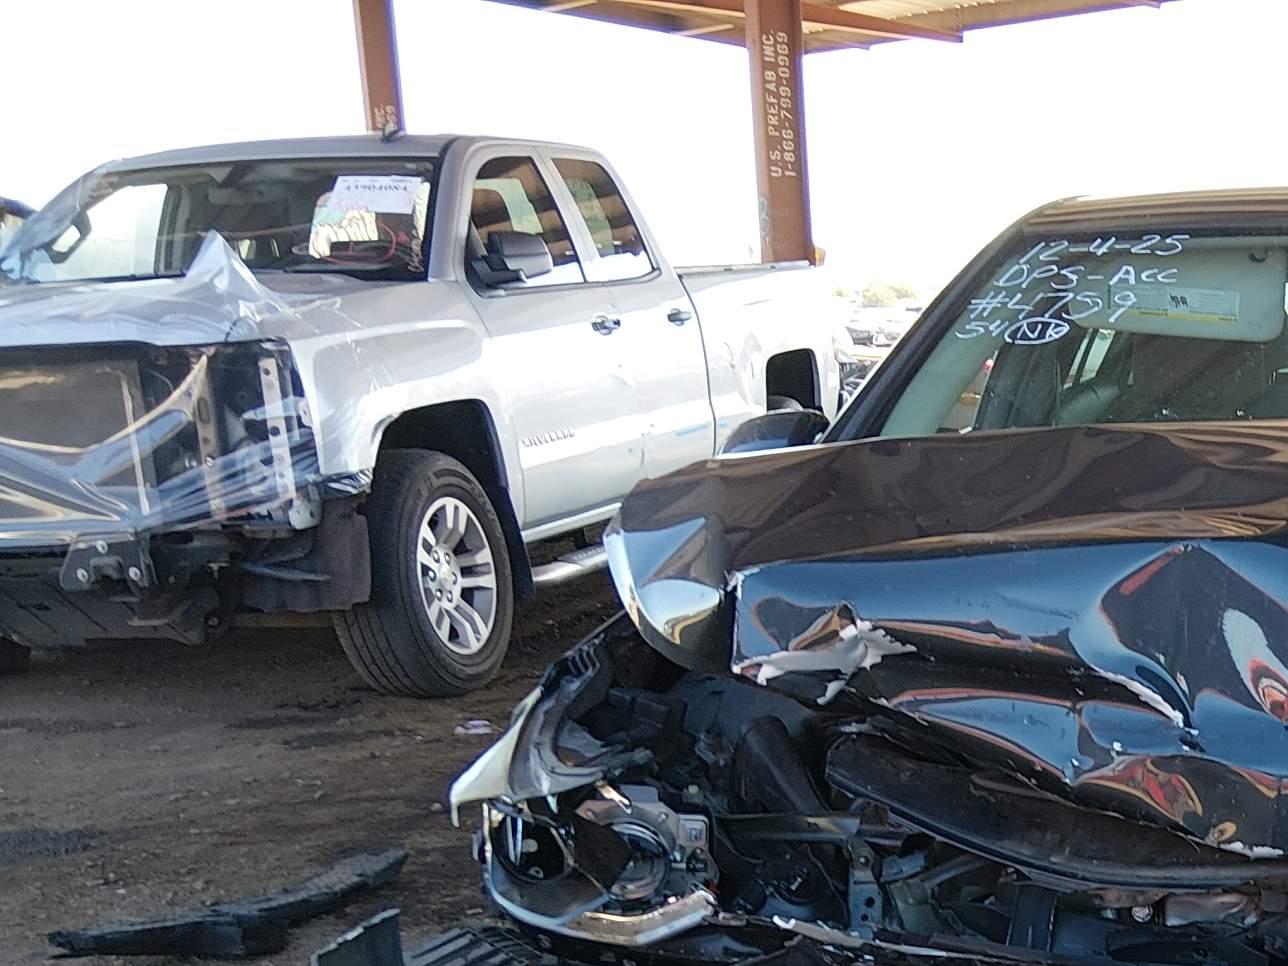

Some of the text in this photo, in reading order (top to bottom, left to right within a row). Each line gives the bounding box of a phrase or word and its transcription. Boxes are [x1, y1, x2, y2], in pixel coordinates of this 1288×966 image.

[761, 29, 783, 177] U.S. PREFAB INC.
[775, 31, 797, 177] 1-866-799-0969
[1018, 235, 1190, 264] 12-4-25
[967, 290, 1137, 323] #4759
